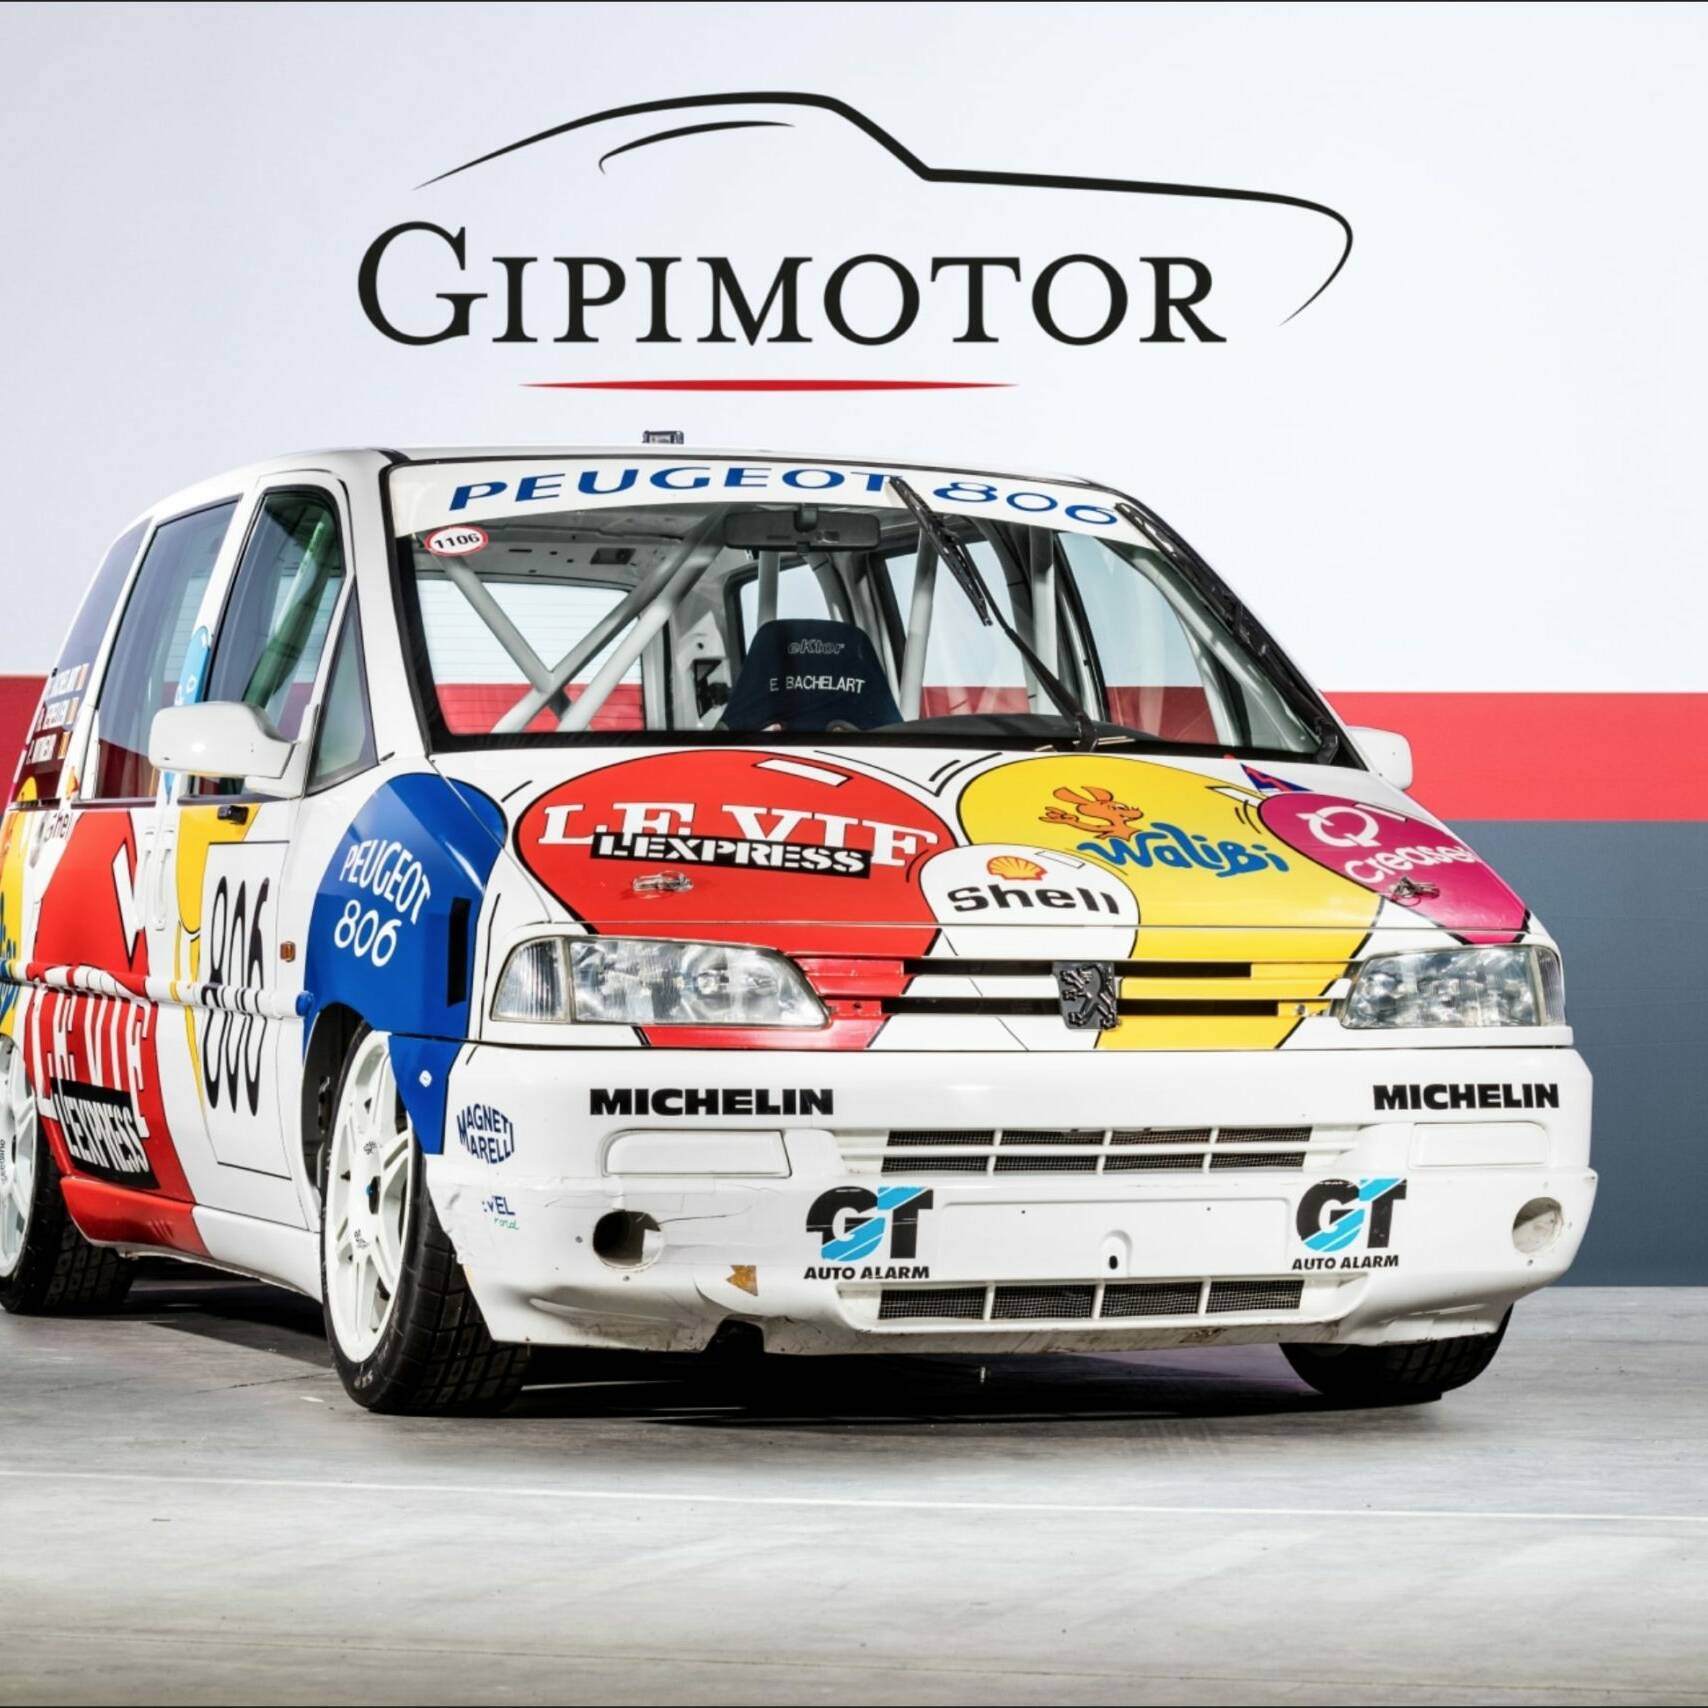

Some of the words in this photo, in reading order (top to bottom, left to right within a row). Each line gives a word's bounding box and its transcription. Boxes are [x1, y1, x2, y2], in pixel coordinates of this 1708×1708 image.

[357, 221, 1227, 346] GIPIMOTOR
[450, 466, 903, 512] PEUGEOT
[933, 481, 1119, 525] 806
[433, 533, 481, 550] 1106
[769, 677, 779, 692] E
[785, 675, 866, 694] BACHELART
[338, 839, 431, 926] PEUGEOT
[334, 899, 402, 968] 806
[202, 876, 269, 1117] 806
[589, 1088, 834, 1117] MICHELIN
[1373, 1083, 1559, 1110] MICHELIN
[456, 1103, 515, 1145] MAGNETI
[460, 1133, 515, 1164] MARELLI
[805, 1186, 934, 1262] GT
[1296, 1178, 1407, 1253] GT
[804, 1266, 856, 1280] AUTO
[860, 1266, 930, 1280] ALARM
[1292, 1256, 1337, 1271] AUTO
[1340, 1254, 1400, 1270] ALARM
